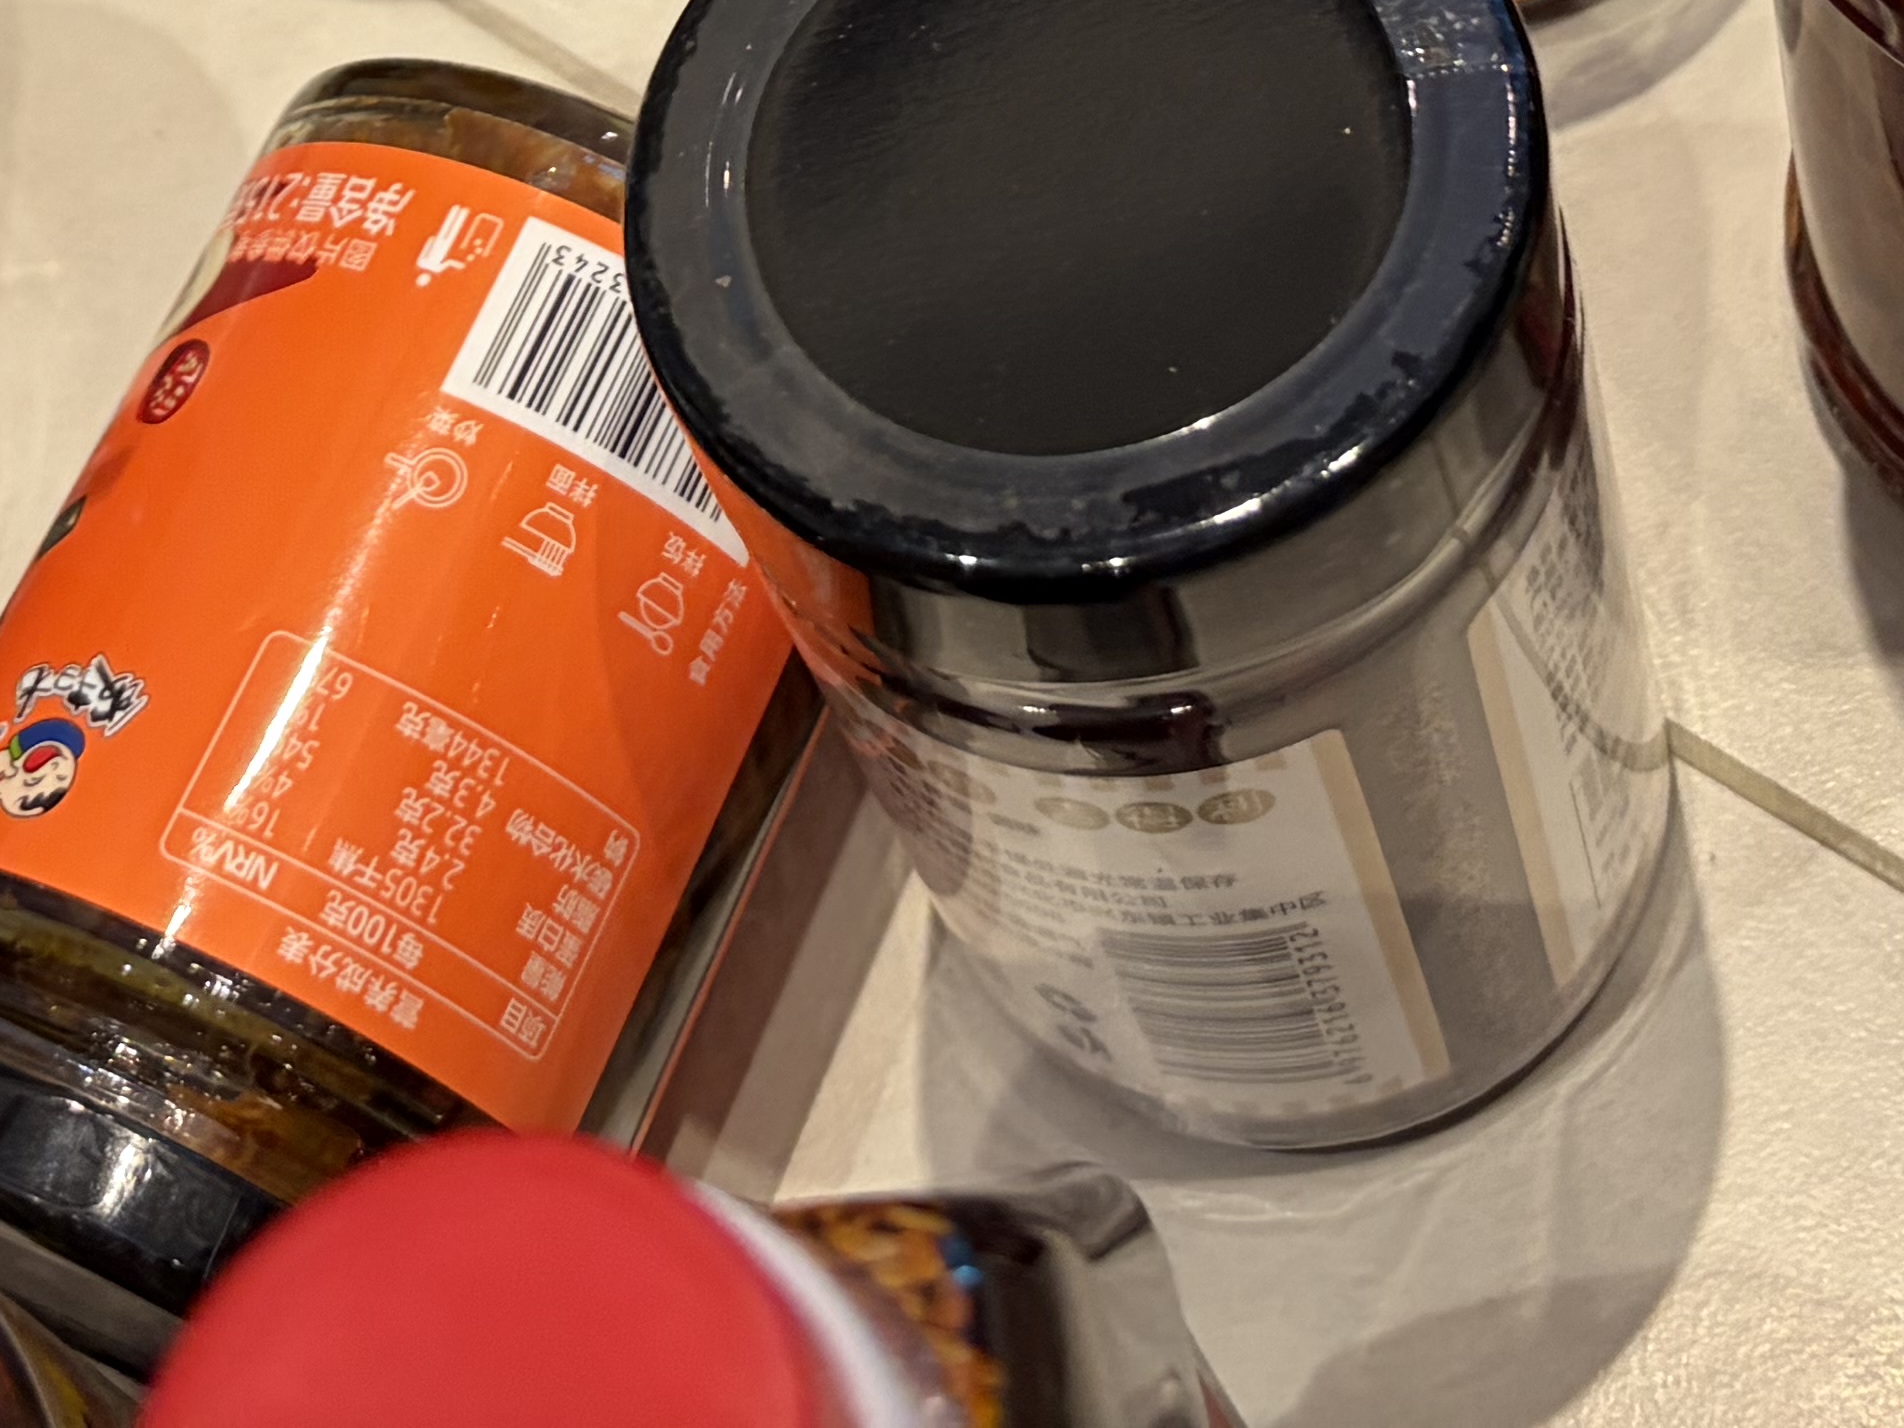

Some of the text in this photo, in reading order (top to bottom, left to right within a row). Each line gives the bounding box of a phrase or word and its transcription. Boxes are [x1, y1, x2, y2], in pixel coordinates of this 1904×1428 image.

[398, 697, 513, 787] 1344毫克
[396, 785, 487, 849] 32.2克
[428, 760, 501, 821] 4.3克
[318, 841, 444, 926] 1305千焦
[391, 826, 472, 892] 2.4克
[501, 805, 618, 905] 碳水化合物
[188, 822, 552, 1051] 项目 每100克 NRV%
[274, 923, 424, 1034] 营养成分表
